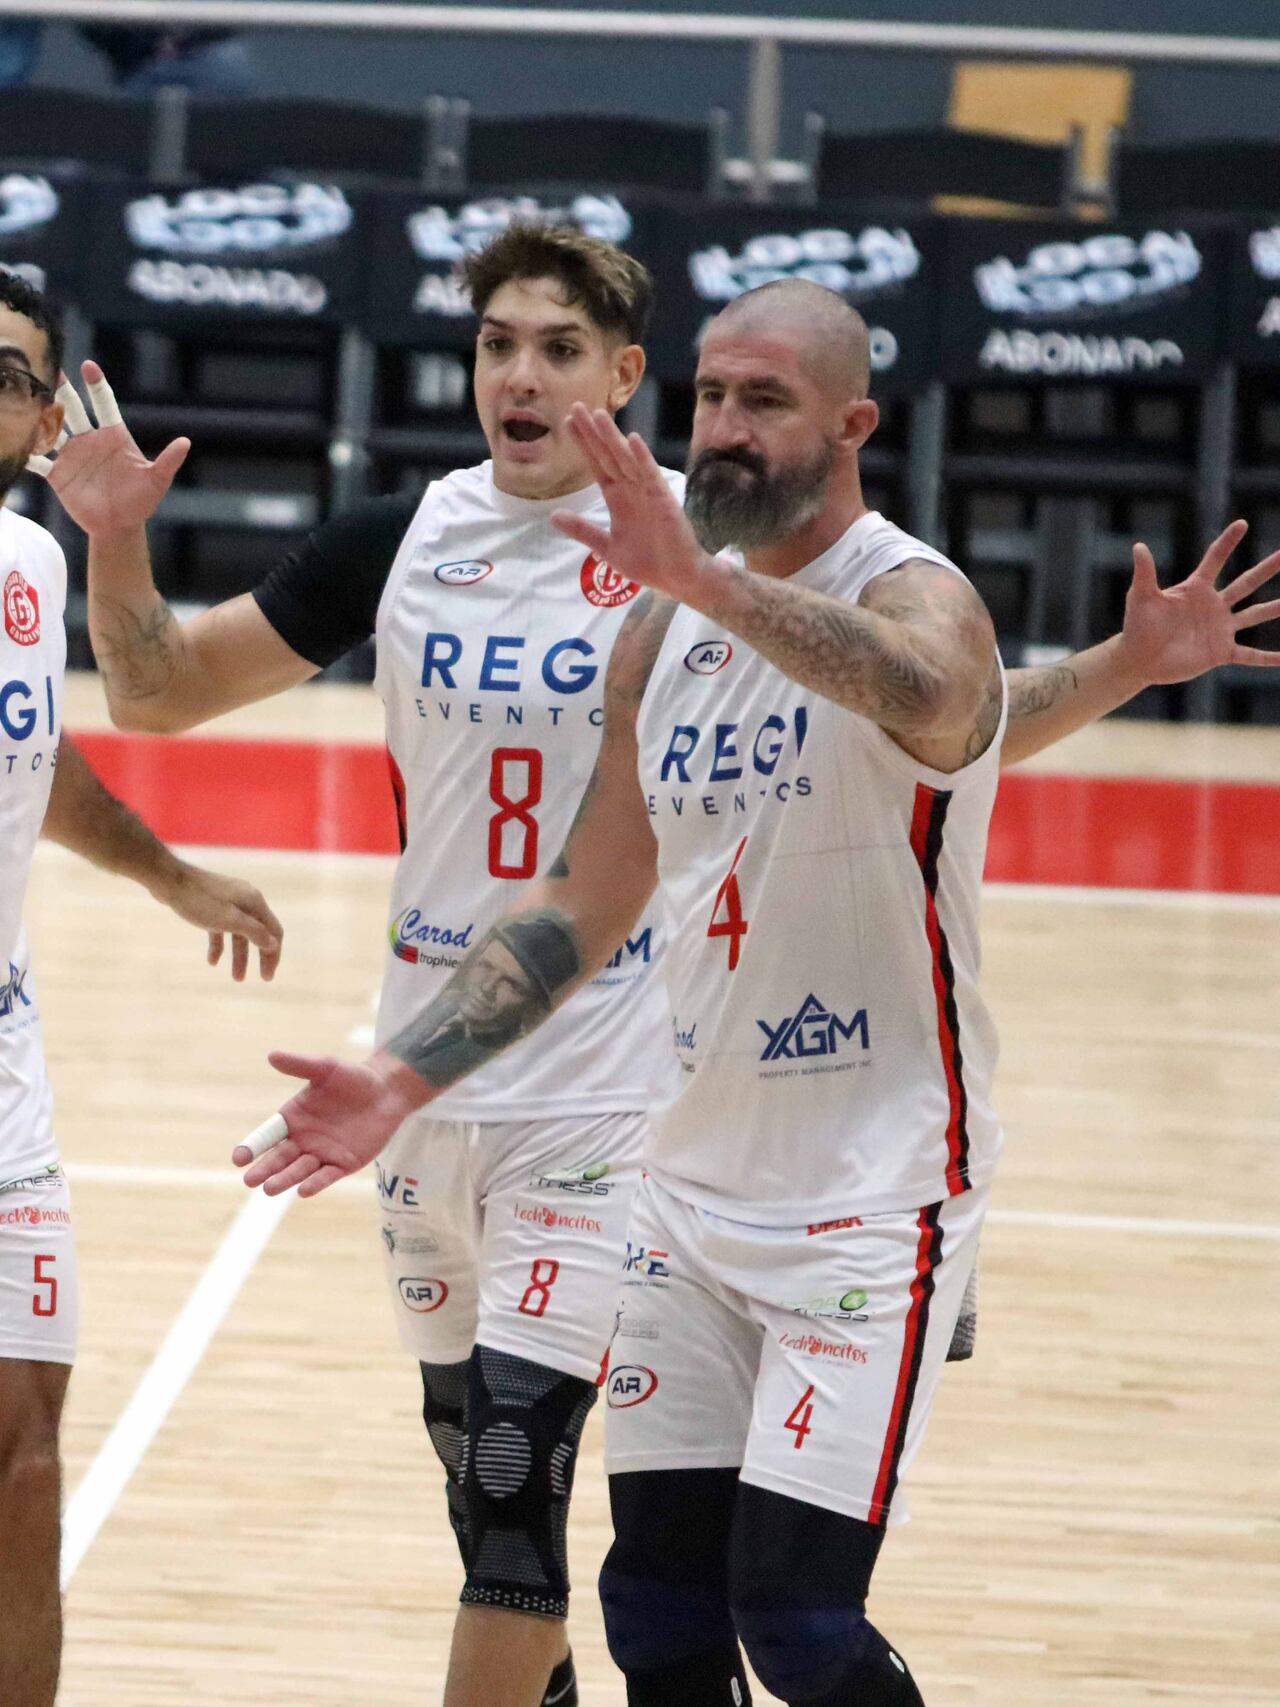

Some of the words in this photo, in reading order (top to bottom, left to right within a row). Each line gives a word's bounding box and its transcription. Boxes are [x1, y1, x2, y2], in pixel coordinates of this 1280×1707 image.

[128, 258, 326, 314] ABONADO
[660, 706, 808, 783] REGI
[488, 747, 543, 880] 8
[648, 776, 812, 815] EVENOS
[401, 909, 473, 948] Carod
[707, 836, 748, 971] 4
[32, 1254, 58, 1317] 5
[406, 1286, 433, 1301] AR
[519, 1257, 560, 1317] 8
[612, 1377, 641, 1395] AR
[784, 1385, 814, 1449] 4
